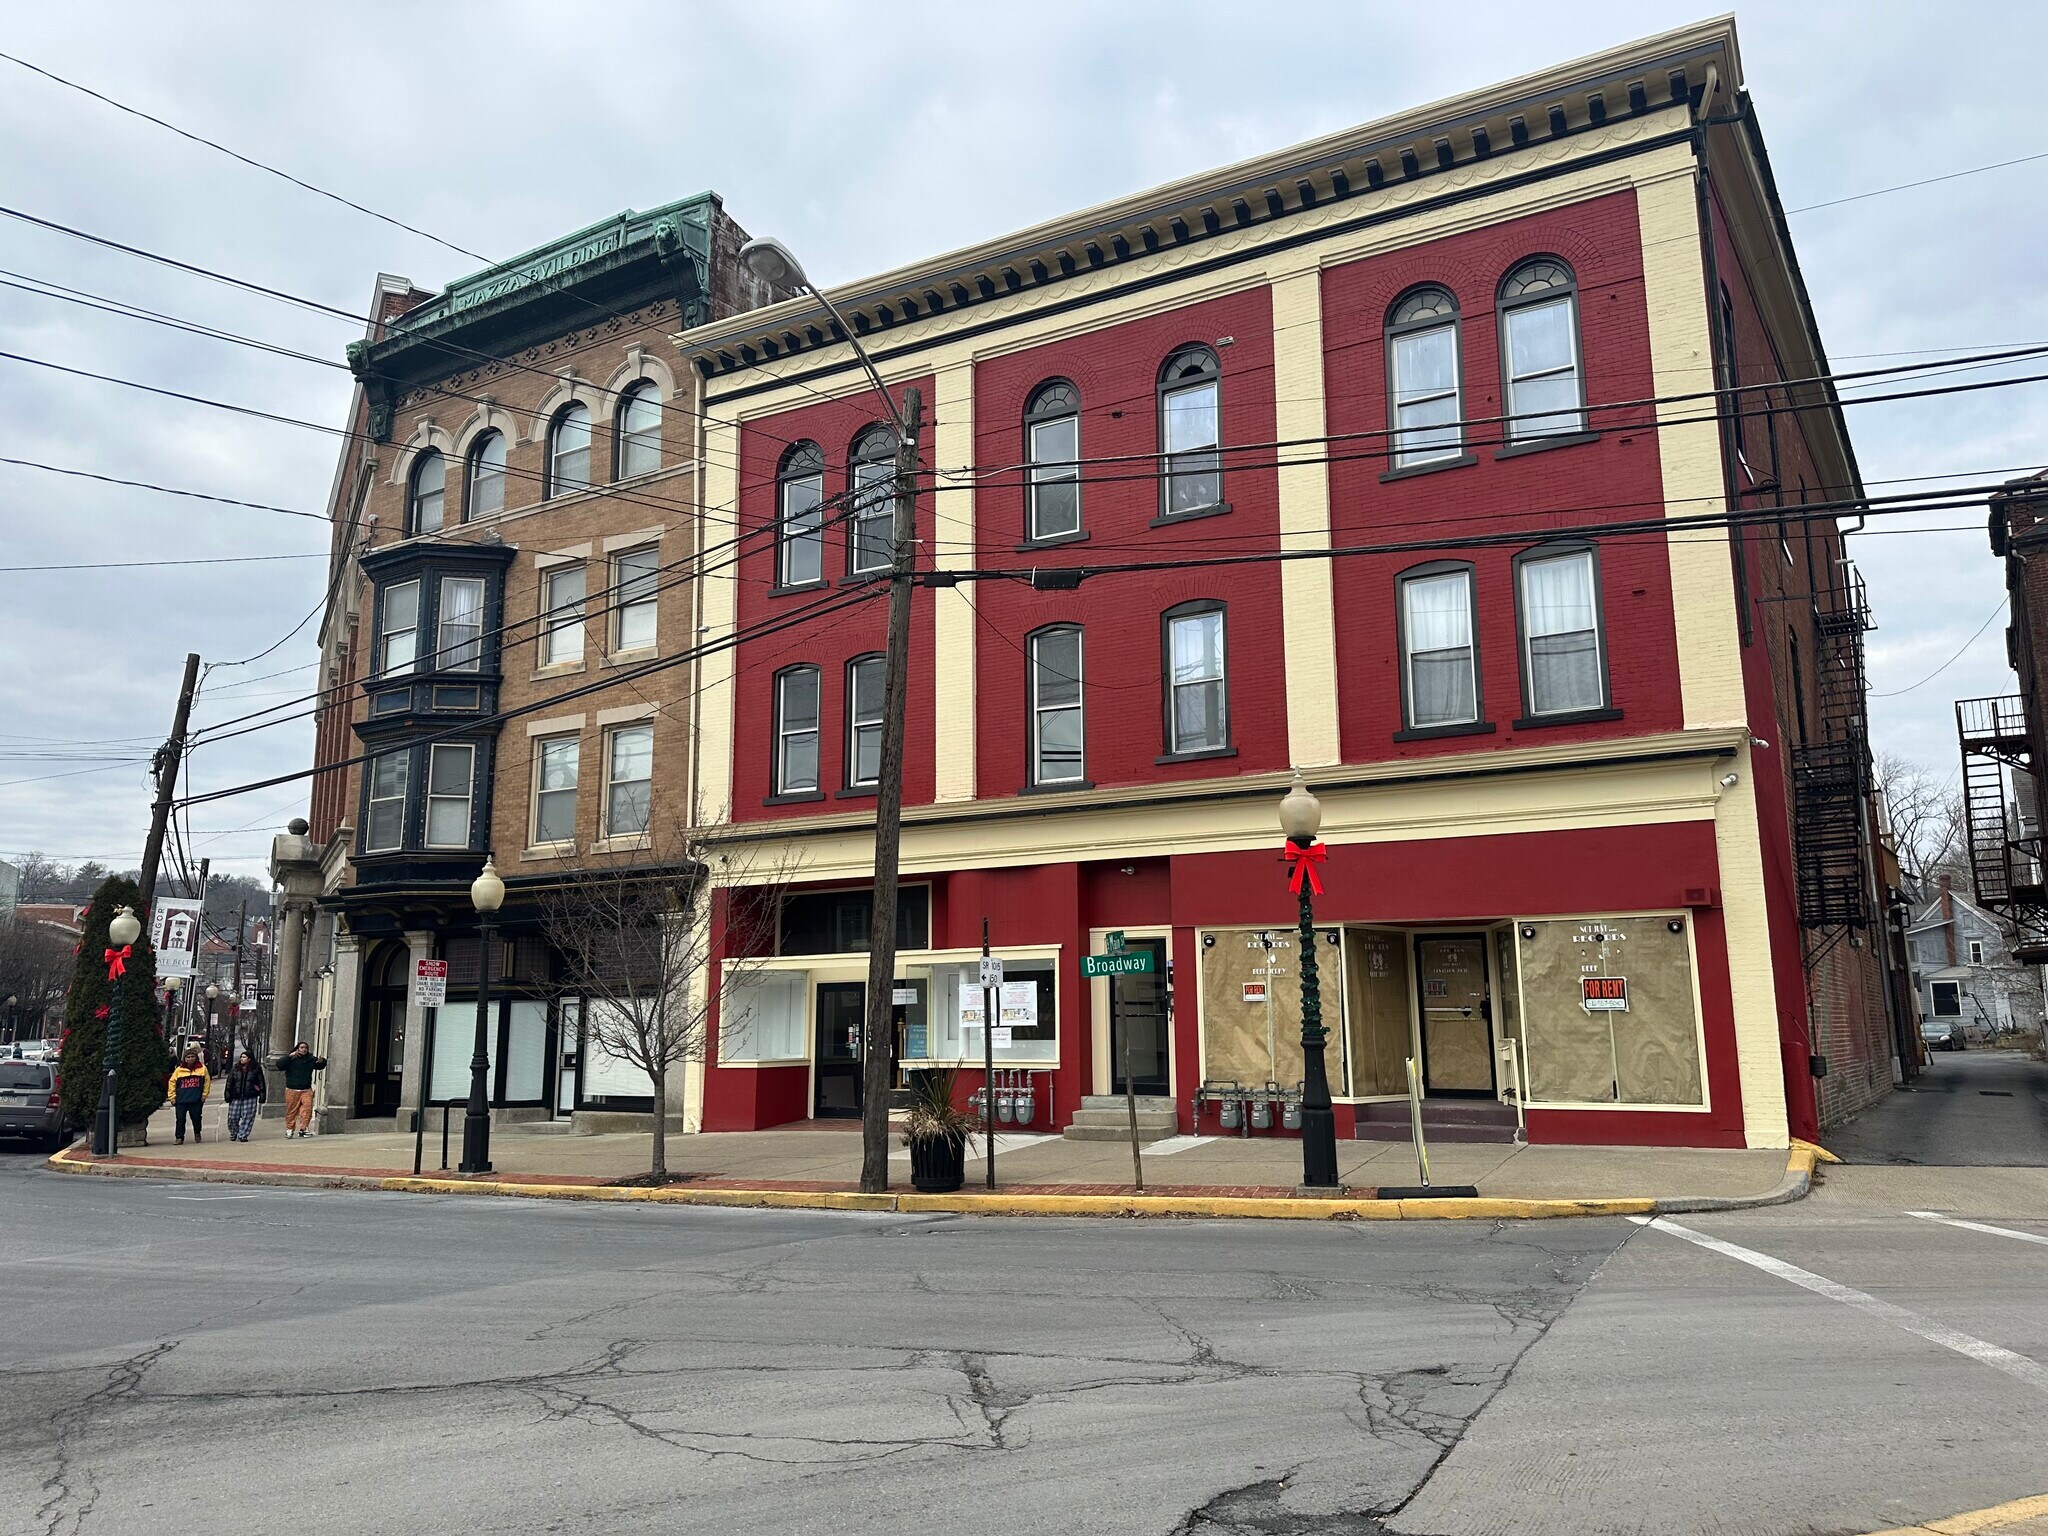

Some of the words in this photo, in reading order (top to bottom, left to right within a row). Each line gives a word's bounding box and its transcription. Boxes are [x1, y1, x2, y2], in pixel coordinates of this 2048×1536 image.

[463, 275, 521, 308] MAZZA
[1579, 925, 1593, 933] NOT
[1572, 933, 1627, 943] RECORDS
[982, 961, 989, 970] SR
[991, 962, 1001, 971] 1015
[1086, 956, 1146, 973] Broadway
[1245, 985, 1253, 994] FOR
[1253, 985, 1264, 994] RENT
[1584, 980, 1600, 998] FOR
[1601, 979, 1624, 998] RENT
